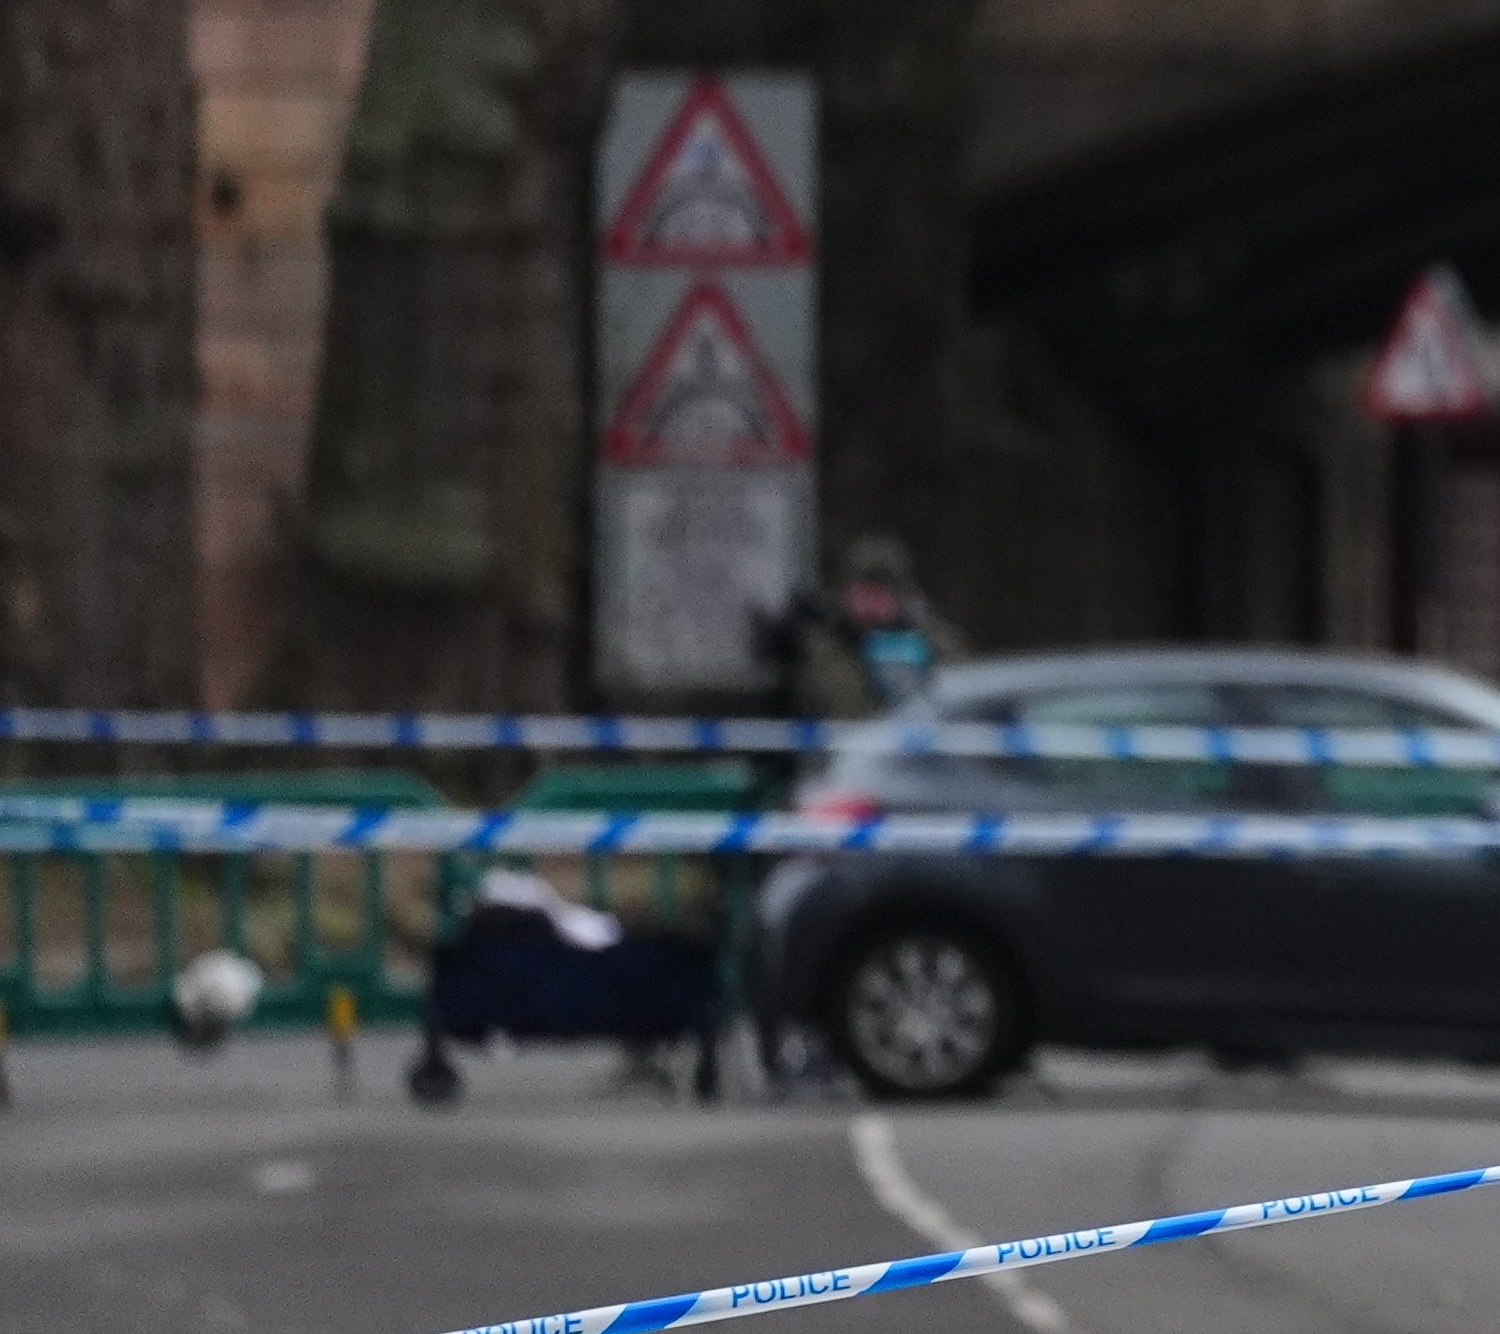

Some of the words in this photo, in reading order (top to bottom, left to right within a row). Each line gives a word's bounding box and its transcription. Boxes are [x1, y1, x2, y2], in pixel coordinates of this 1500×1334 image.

[730, 1270, 852, 1309] POLICE
[996, 1227, 1118, 1264] POLICE
[1261, 1185, 1382, 1220] POLICE
